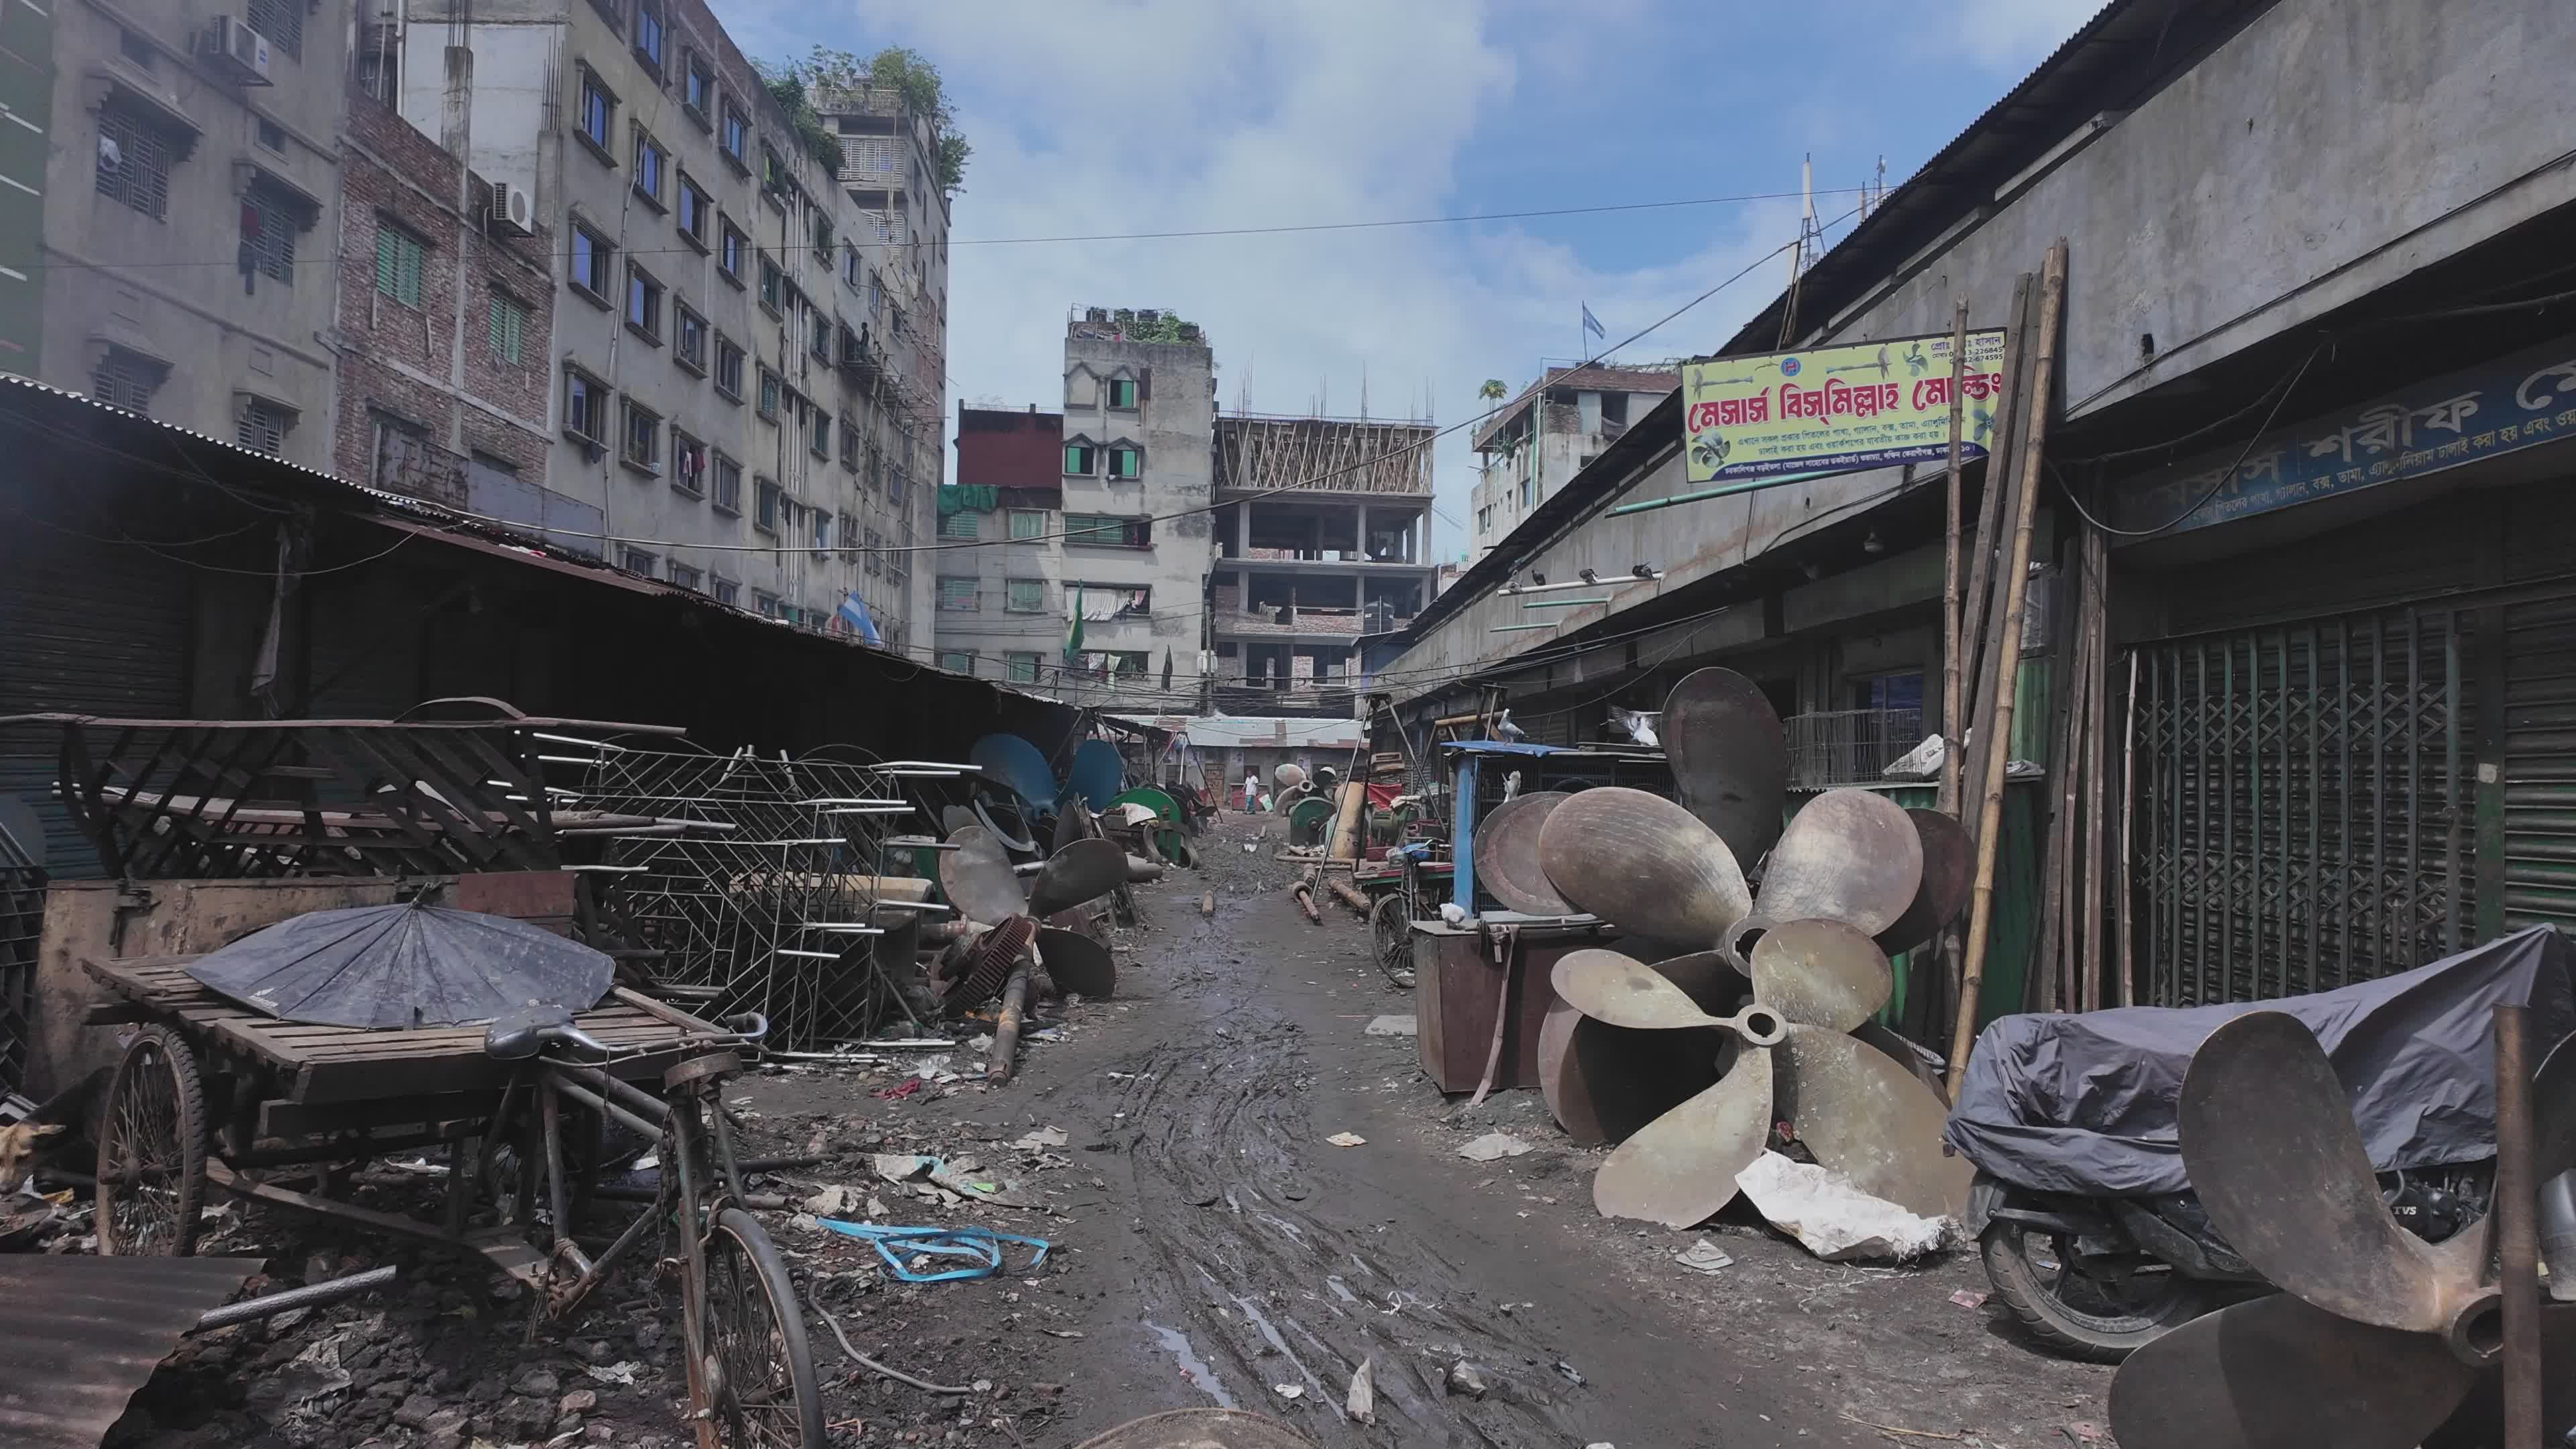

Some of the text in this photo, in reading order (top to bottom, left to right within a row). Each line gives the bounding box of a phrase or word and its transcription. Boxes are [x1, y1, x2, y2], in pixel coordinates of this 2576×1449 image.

[1688, 386, 1771, 434] মেসার্স
[2300, 391, 2483, 462] শরীফ
[2436, 436, 2469, 459] ঢালাই
[2472, 429, 2496, 448] করা
[2499, 425, 2518, 443] হয়
[2523, 417, 2552, 435] এবং
[2393, 1205, 2417, 1216] TVS
